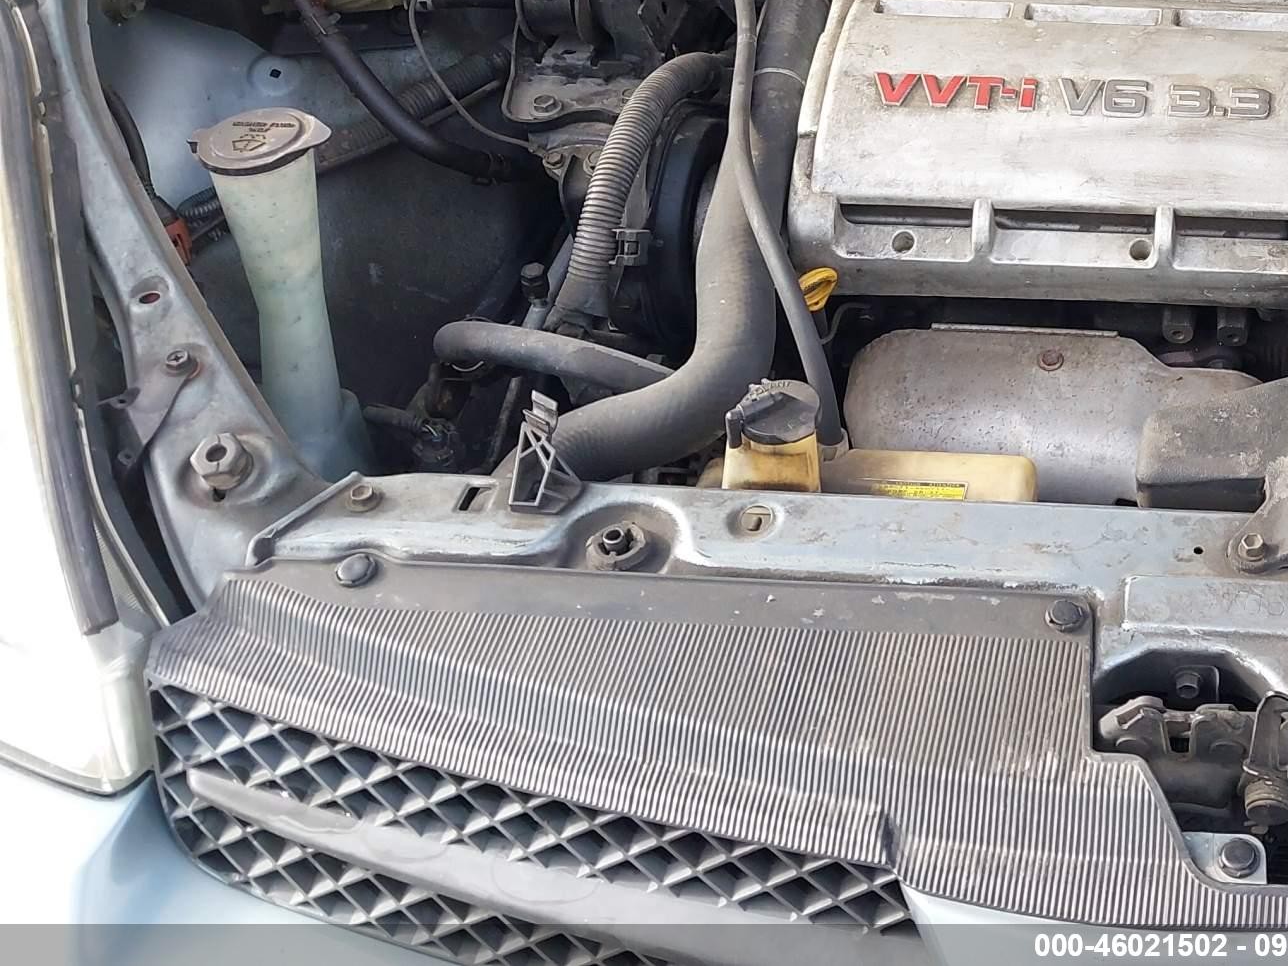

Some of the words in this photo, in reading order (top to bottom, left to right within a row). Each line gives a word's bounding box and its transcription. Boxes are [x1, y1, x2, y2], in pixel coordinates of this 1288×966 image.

[874, 71, 1038, 112] VVT-i
[1058, 78, 1151, 118] V6
[1167, 81, 1273, 121] 3.3
